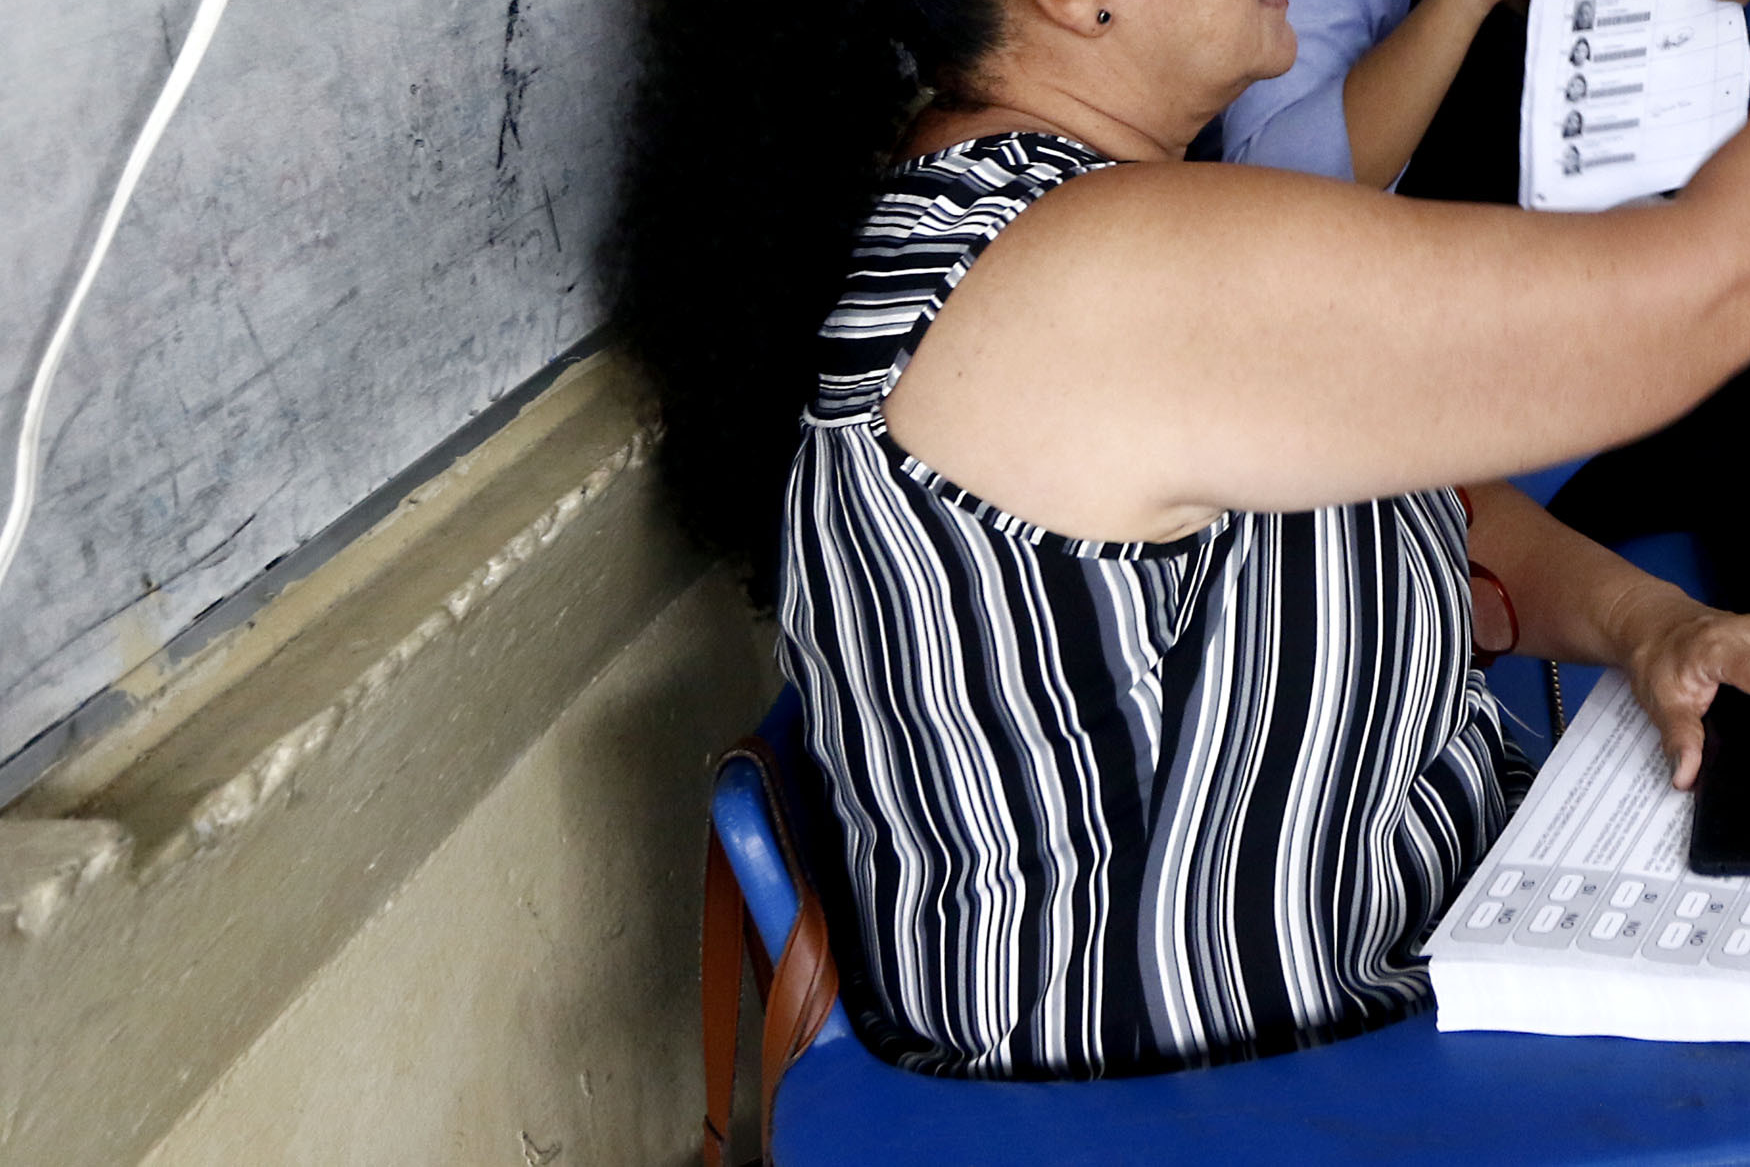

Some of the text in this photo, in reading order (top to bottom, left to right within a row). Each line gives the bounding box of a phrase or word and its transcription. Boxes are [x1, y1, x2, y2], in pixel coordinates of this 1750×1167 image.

[1498, 908, 1516, 925] NO
[1561, 913, 1579, 929] NO
[1623, 920, 1641, 937] NO
[1690, 929, 1708, 946] NO
